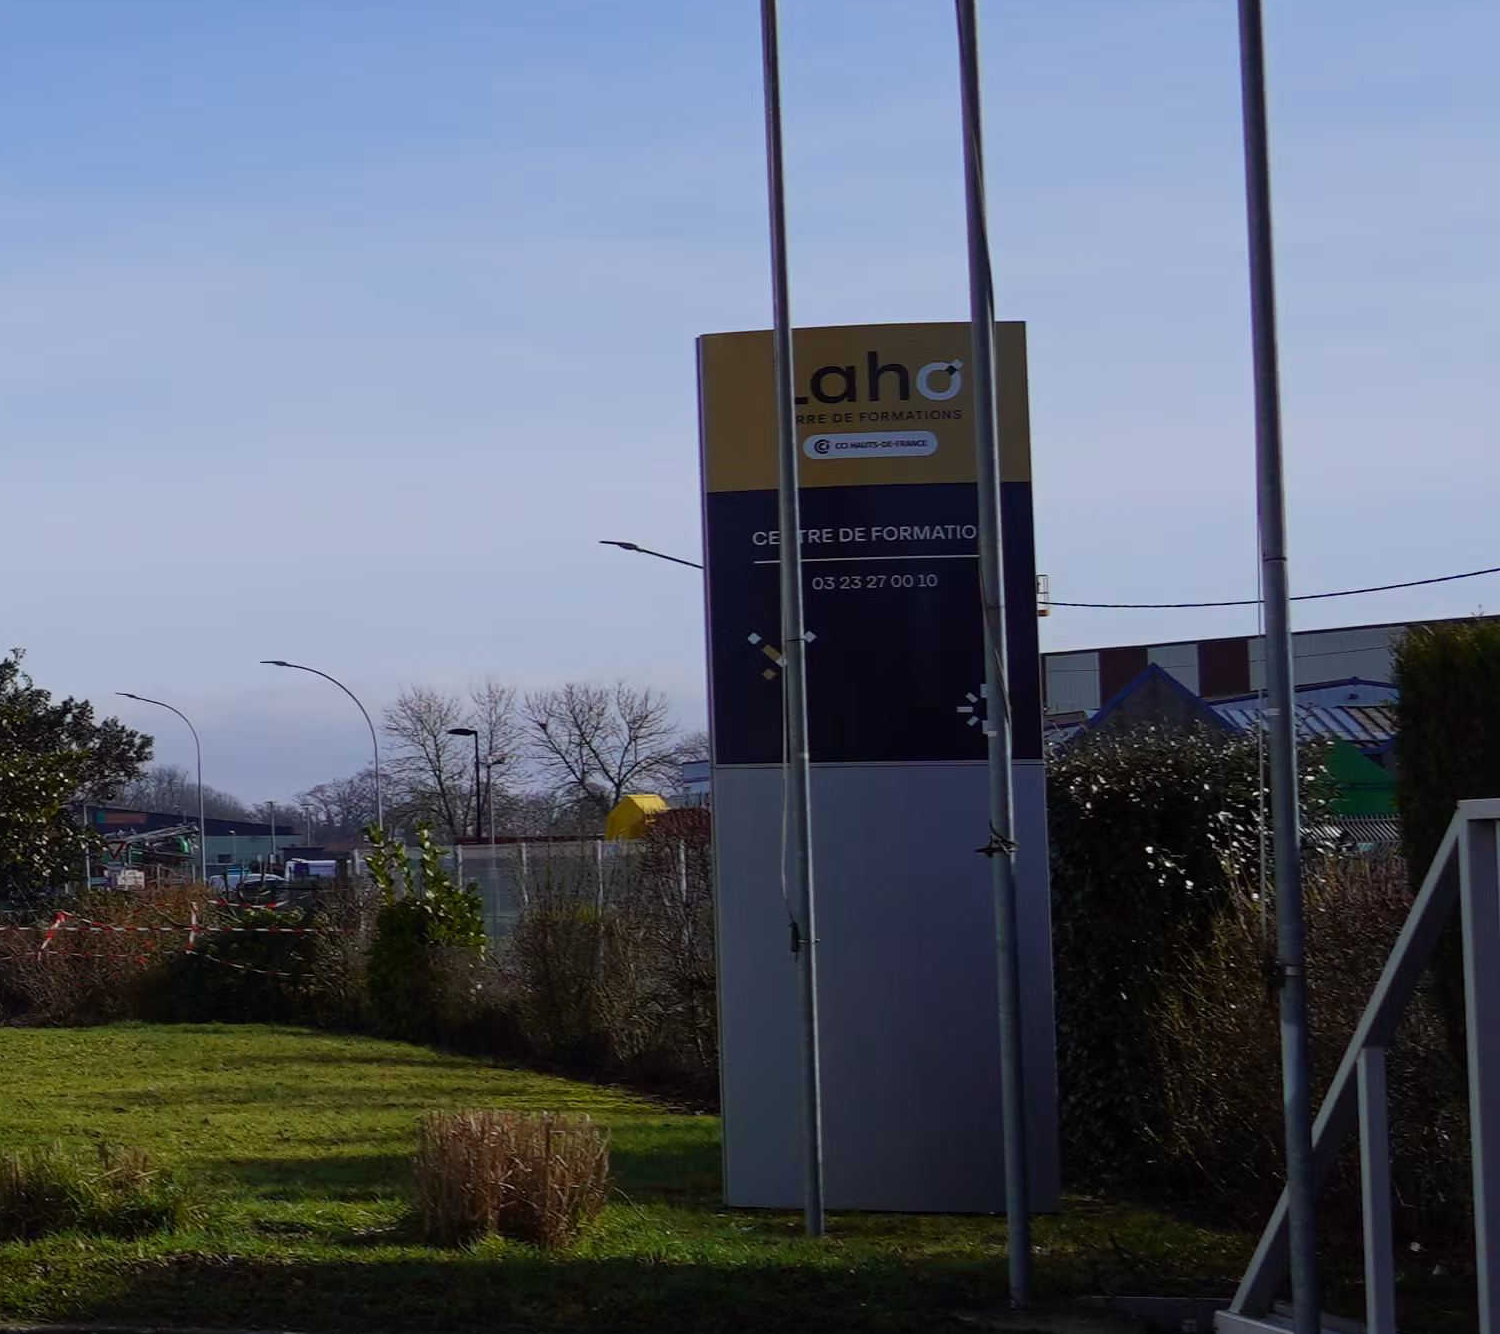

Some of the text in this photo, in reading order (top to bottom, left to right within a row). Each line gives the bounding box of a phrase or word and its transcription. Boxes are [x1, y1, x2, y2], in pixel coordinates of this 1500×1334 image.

[794, 351, 963, 404] aho
[795, 409, 963, 425] RRE DE FORMATIONS
[850, 439, 929, 450] HAUTS-DE-FRANCE
[752, 524, 977, 546] CETRE DE FORMATIO
[812, 573, 938, 590] 03 23 27 00 10
